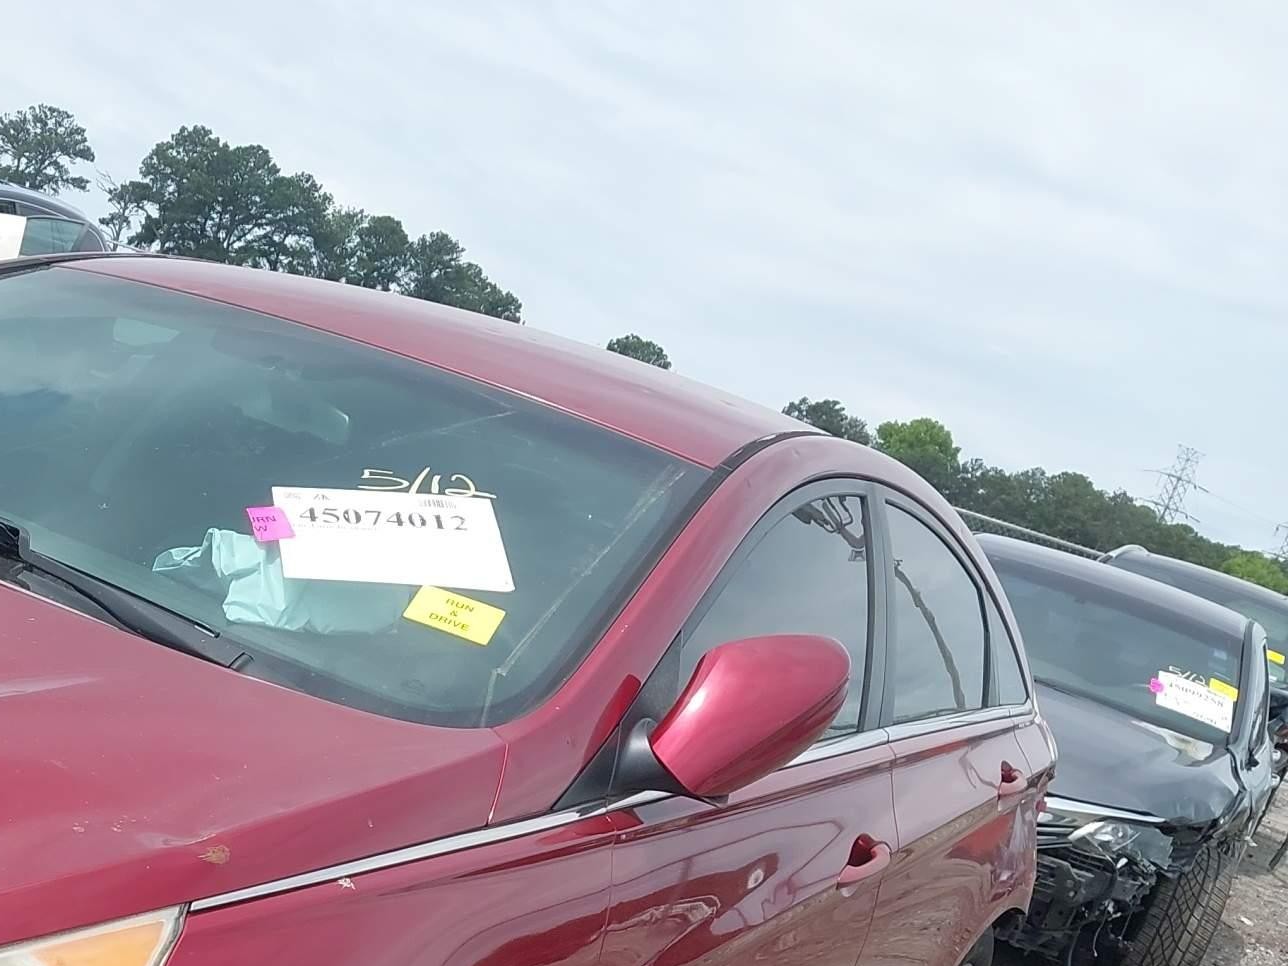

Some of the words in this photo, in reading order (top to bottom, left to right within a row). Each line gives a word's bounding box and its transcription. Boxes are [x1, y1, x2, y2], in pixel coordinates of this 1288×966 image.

[357, 466, 497, 500] 5/12
[299, 506, 468, 531] 45074012
[446, 598, 475, 612] RUN
[428, 612, 471, 632] DRIVE
